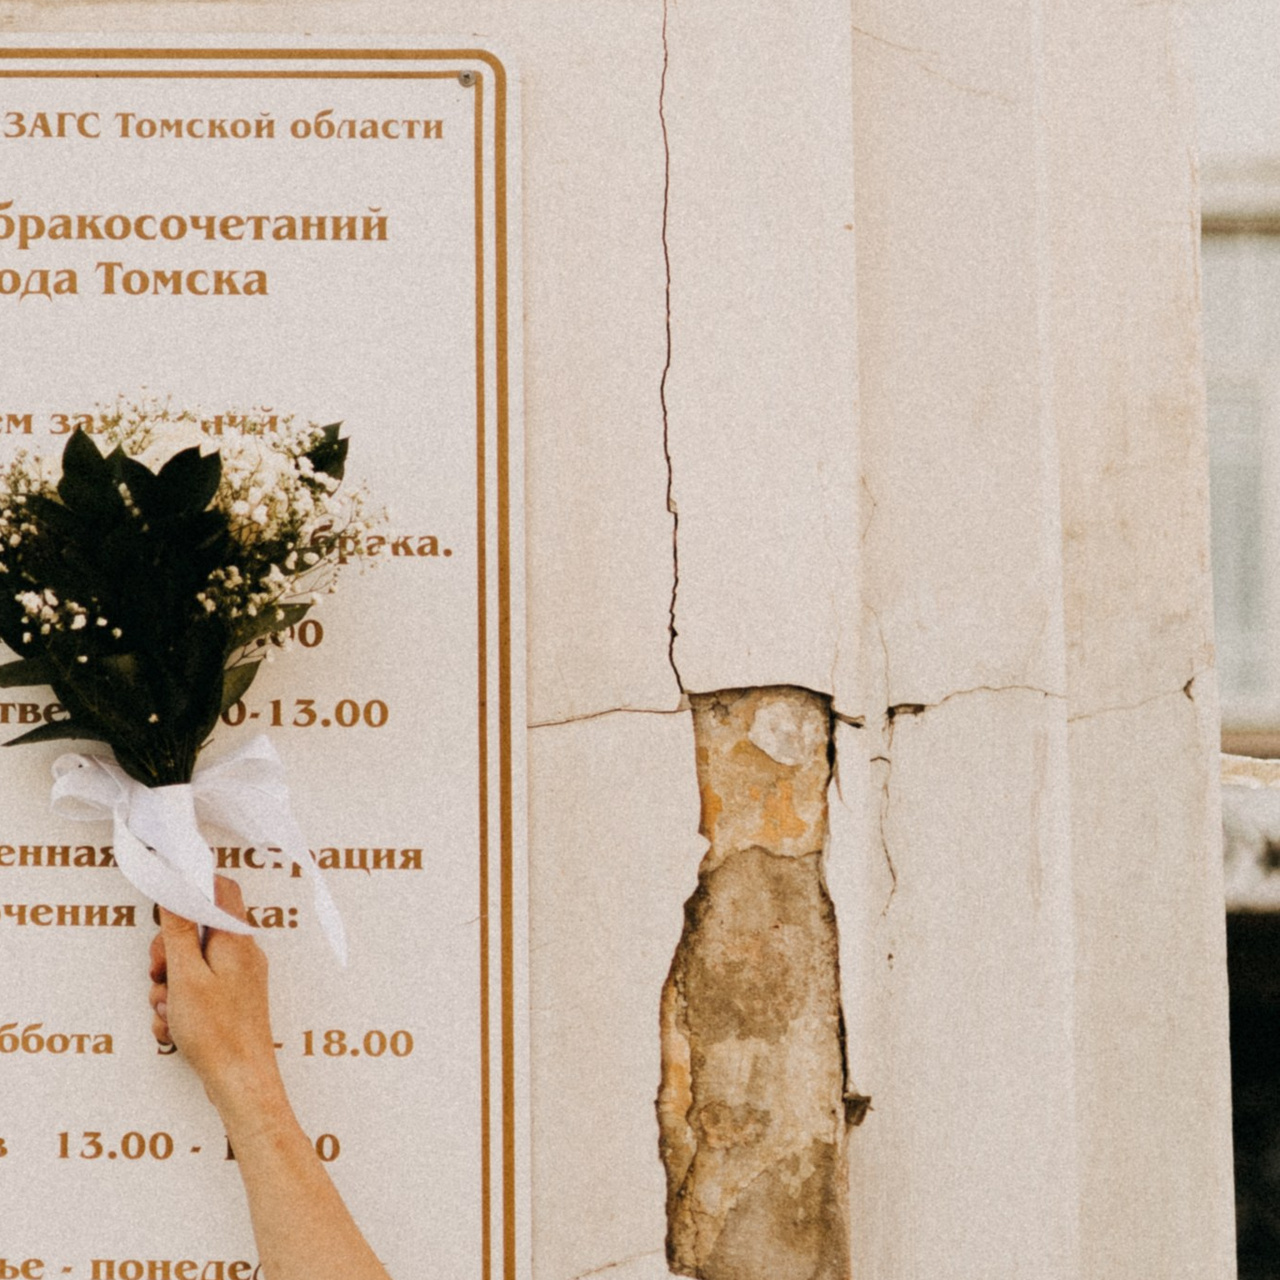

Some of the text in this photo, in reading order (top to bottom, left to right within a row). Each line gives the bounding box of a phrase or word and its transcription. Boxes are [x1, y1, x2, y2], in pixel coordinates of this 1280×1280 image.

[6, 112, 98, 138] ЗАГС
[116, 113, 274, 138] Томской
[290, 109, 443, 139] области
[97, 262, 267, 295] Томска
[304, 1030, 413, 1056] 18.00
[60, 1132, 174, 1160] 13.00
